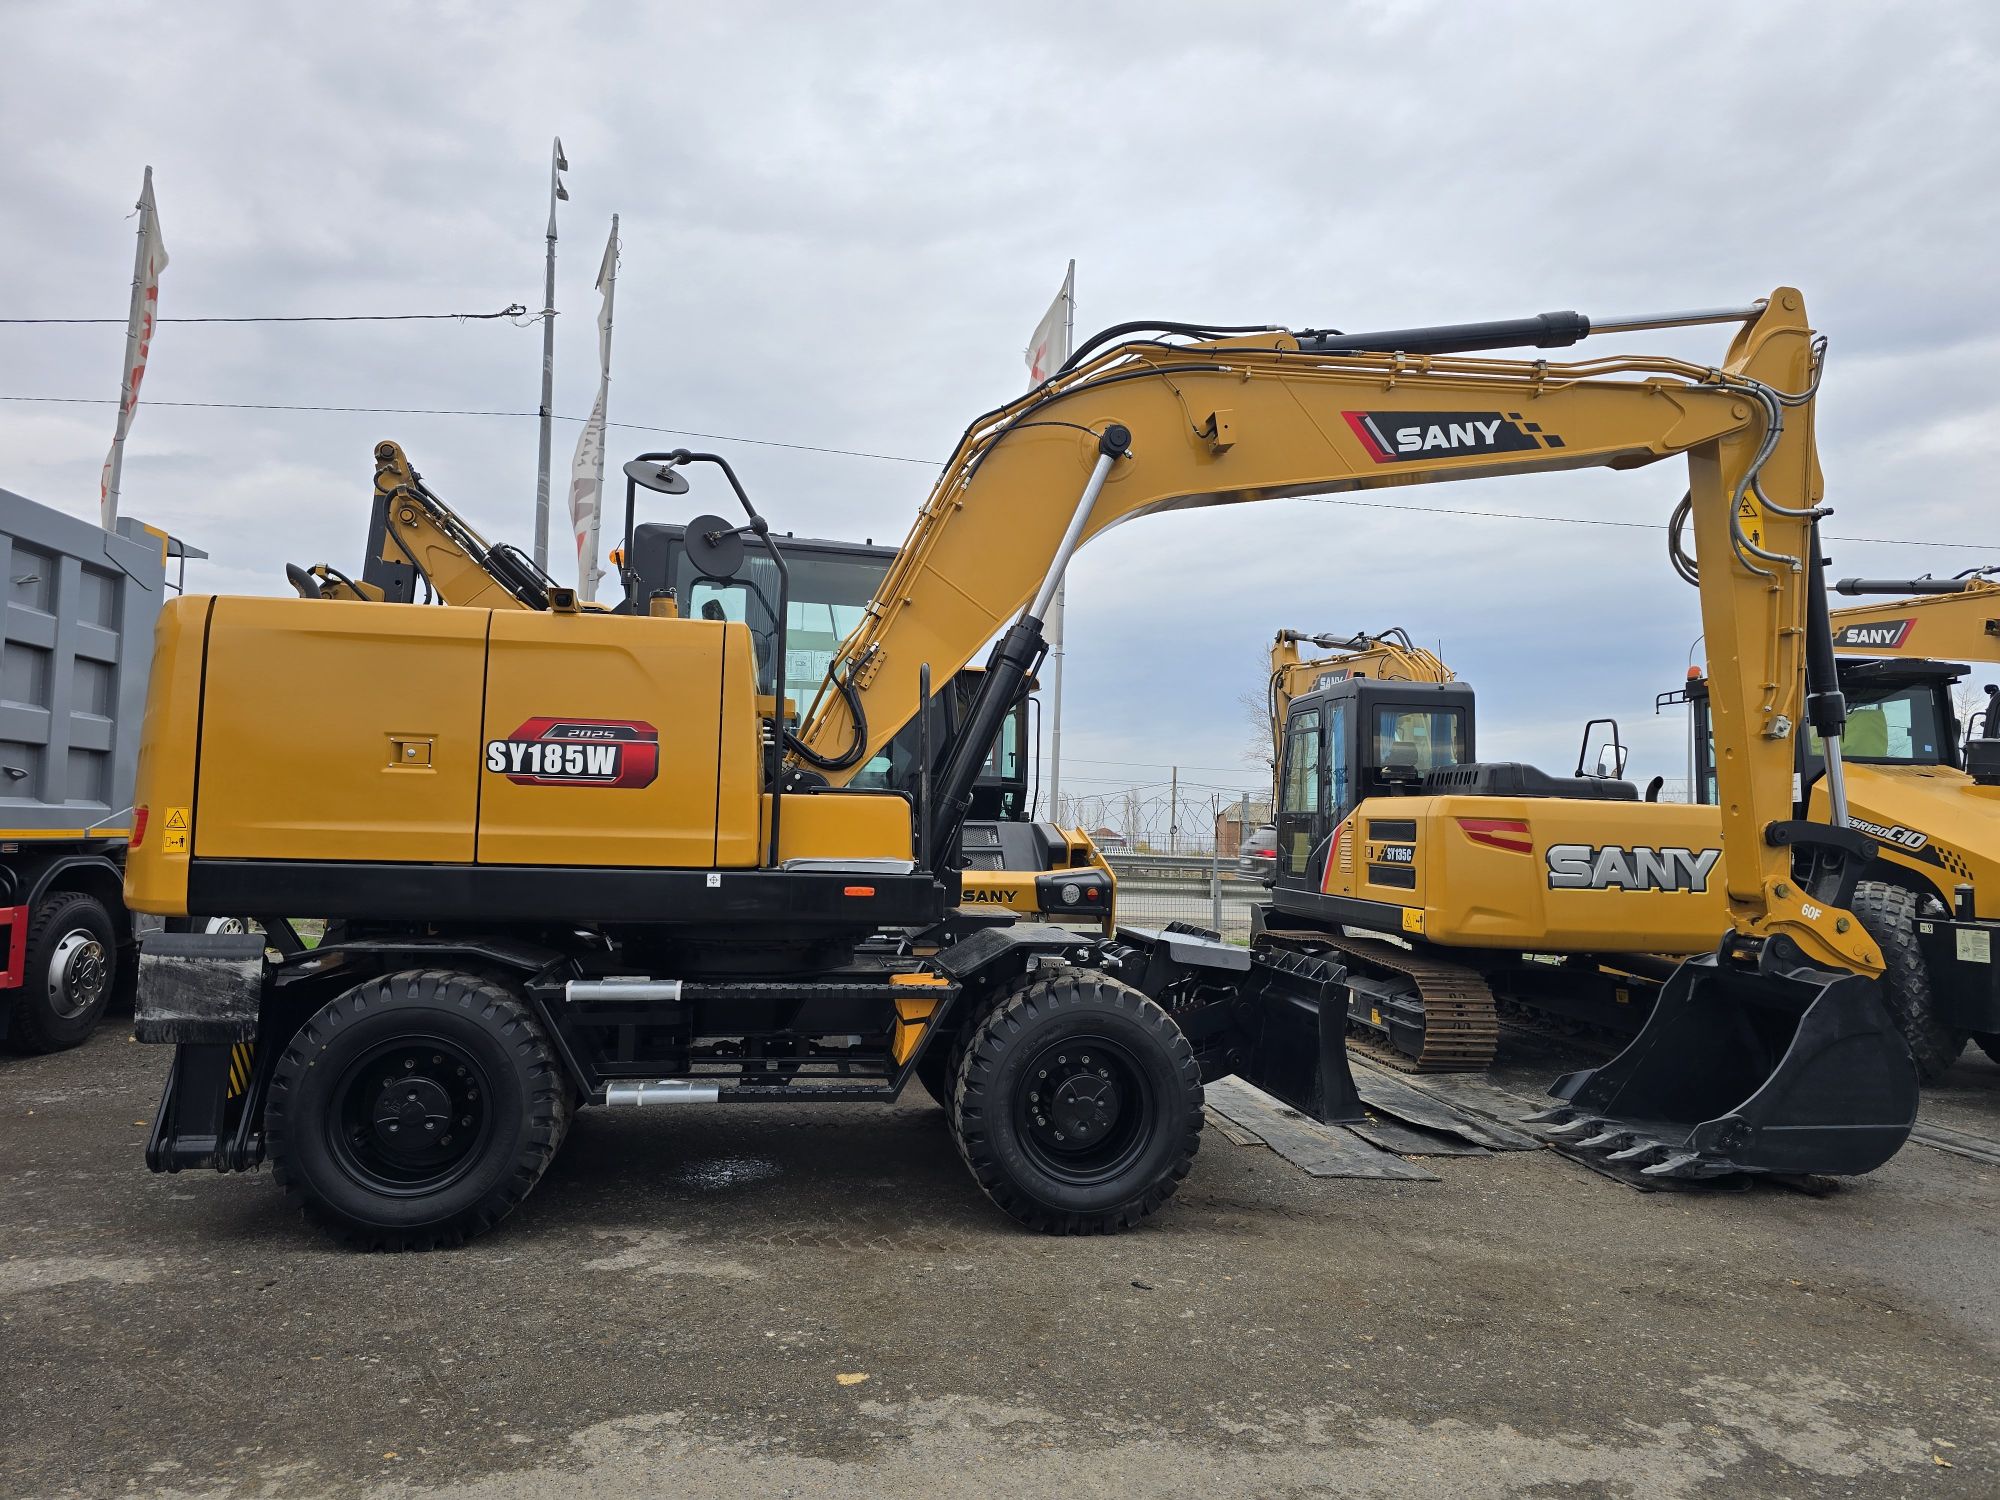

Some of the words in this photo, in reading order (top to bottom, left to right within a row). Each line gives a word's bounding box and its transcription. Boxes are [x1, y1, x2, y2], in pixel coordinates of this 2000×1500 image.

[1396, 419, 1502, 453] SANY
[1846, 628, 1896, 644] SANY
[567, 729, 616, 739] 2025
[487, 741, 617, 775] SY185W
[1386, 847, 1412, 861] SY135C
[1547, 844, 1722, 892] SANY
[961, 889, 1018, 904] SANY
[1801, 903, 1822, 921] 60F
